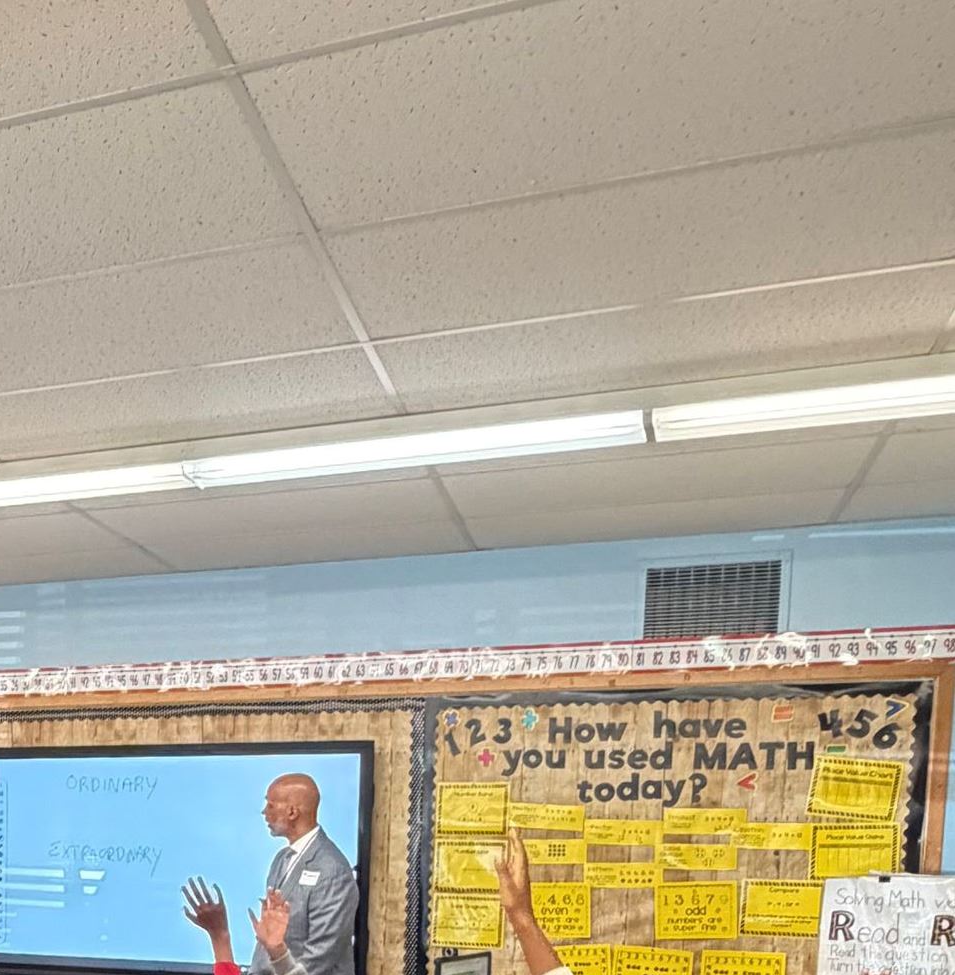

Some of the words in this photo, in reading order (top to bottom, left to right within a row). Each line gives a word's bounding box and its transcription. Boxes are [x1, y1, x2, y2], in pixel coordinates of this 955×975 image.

[80, 676, 89, 688] 42
[117, 674, 126, 687] 45
[129, 674, 138, 686] 46
[142, 673, 151, 686] 47
[259, 668, 268, 681] 56
[272, 668, 282, 681] 57
[300, 666, 309, 679] 59
[313, 666, 323, 679] 60
[328, 666, 335, 678] 61
[355, 664, 365, 677] 63
[384, 663, 394, 676] 65
[399, 662, 409, 675] 66
[413, 661, 423, 674] 67
[444, 660, 454, 673] 69
[521, 657, 532, 670] 74
[536, 656, 547, 671] 75
[553, 655, 563, 669] 76
[569, 655, 580, 669] 77
[585, 654, 596, 668] 78
[602, 653, 613, 667] 79
[618, 652, 629, 667] 80
[636, 652, 645, 666] 81
[652, 651, 663, 665] 82
[669, 650, 681, 664] 83
[686, 650, 698, 664] 84
[738, 647, 751, 661] 87
[774, 645, 787, 660] 89
[811, 644, 821, 658] 91
[828, 643, 841, 658] 92
[847, 642, 859, 657] 93
[865, 641, 879, 656] 94
[885, 640, 898, 656] 95
[904, 639, 916, 655] 96
[444, 730, 461, 756] 1
[465, 718, 486, 747] 2
[493, 718, 512, 744] 3
[548, 717, 628, 744] How
[653, 710, 747, 739] have
[818, 709, 843, 738] 4
[846, 708, 879, 738] 5
[872, 722, 903, 749] 6
[501, 750, 566, 777] you
[585, 741, 674, 770] used
[695, 741, 814, 770] MATH
[66, 774, 158, 800] ORDINARY
[576, 772, 708, 807] today?
[541, 907, 569, 916] even
[663, 895, 669, 906] 1
[674, 895, 685, 906] 3
[706, 894, 716, 905] 7
[685, 906, 707, 916] odd
[888, 889, 926, 911] Math
[667, 916, 703, 924] numbers
[673, 924, 696, 932] super
[828, 910, 901, 944] Read
[883, 947, 949, 966] question
